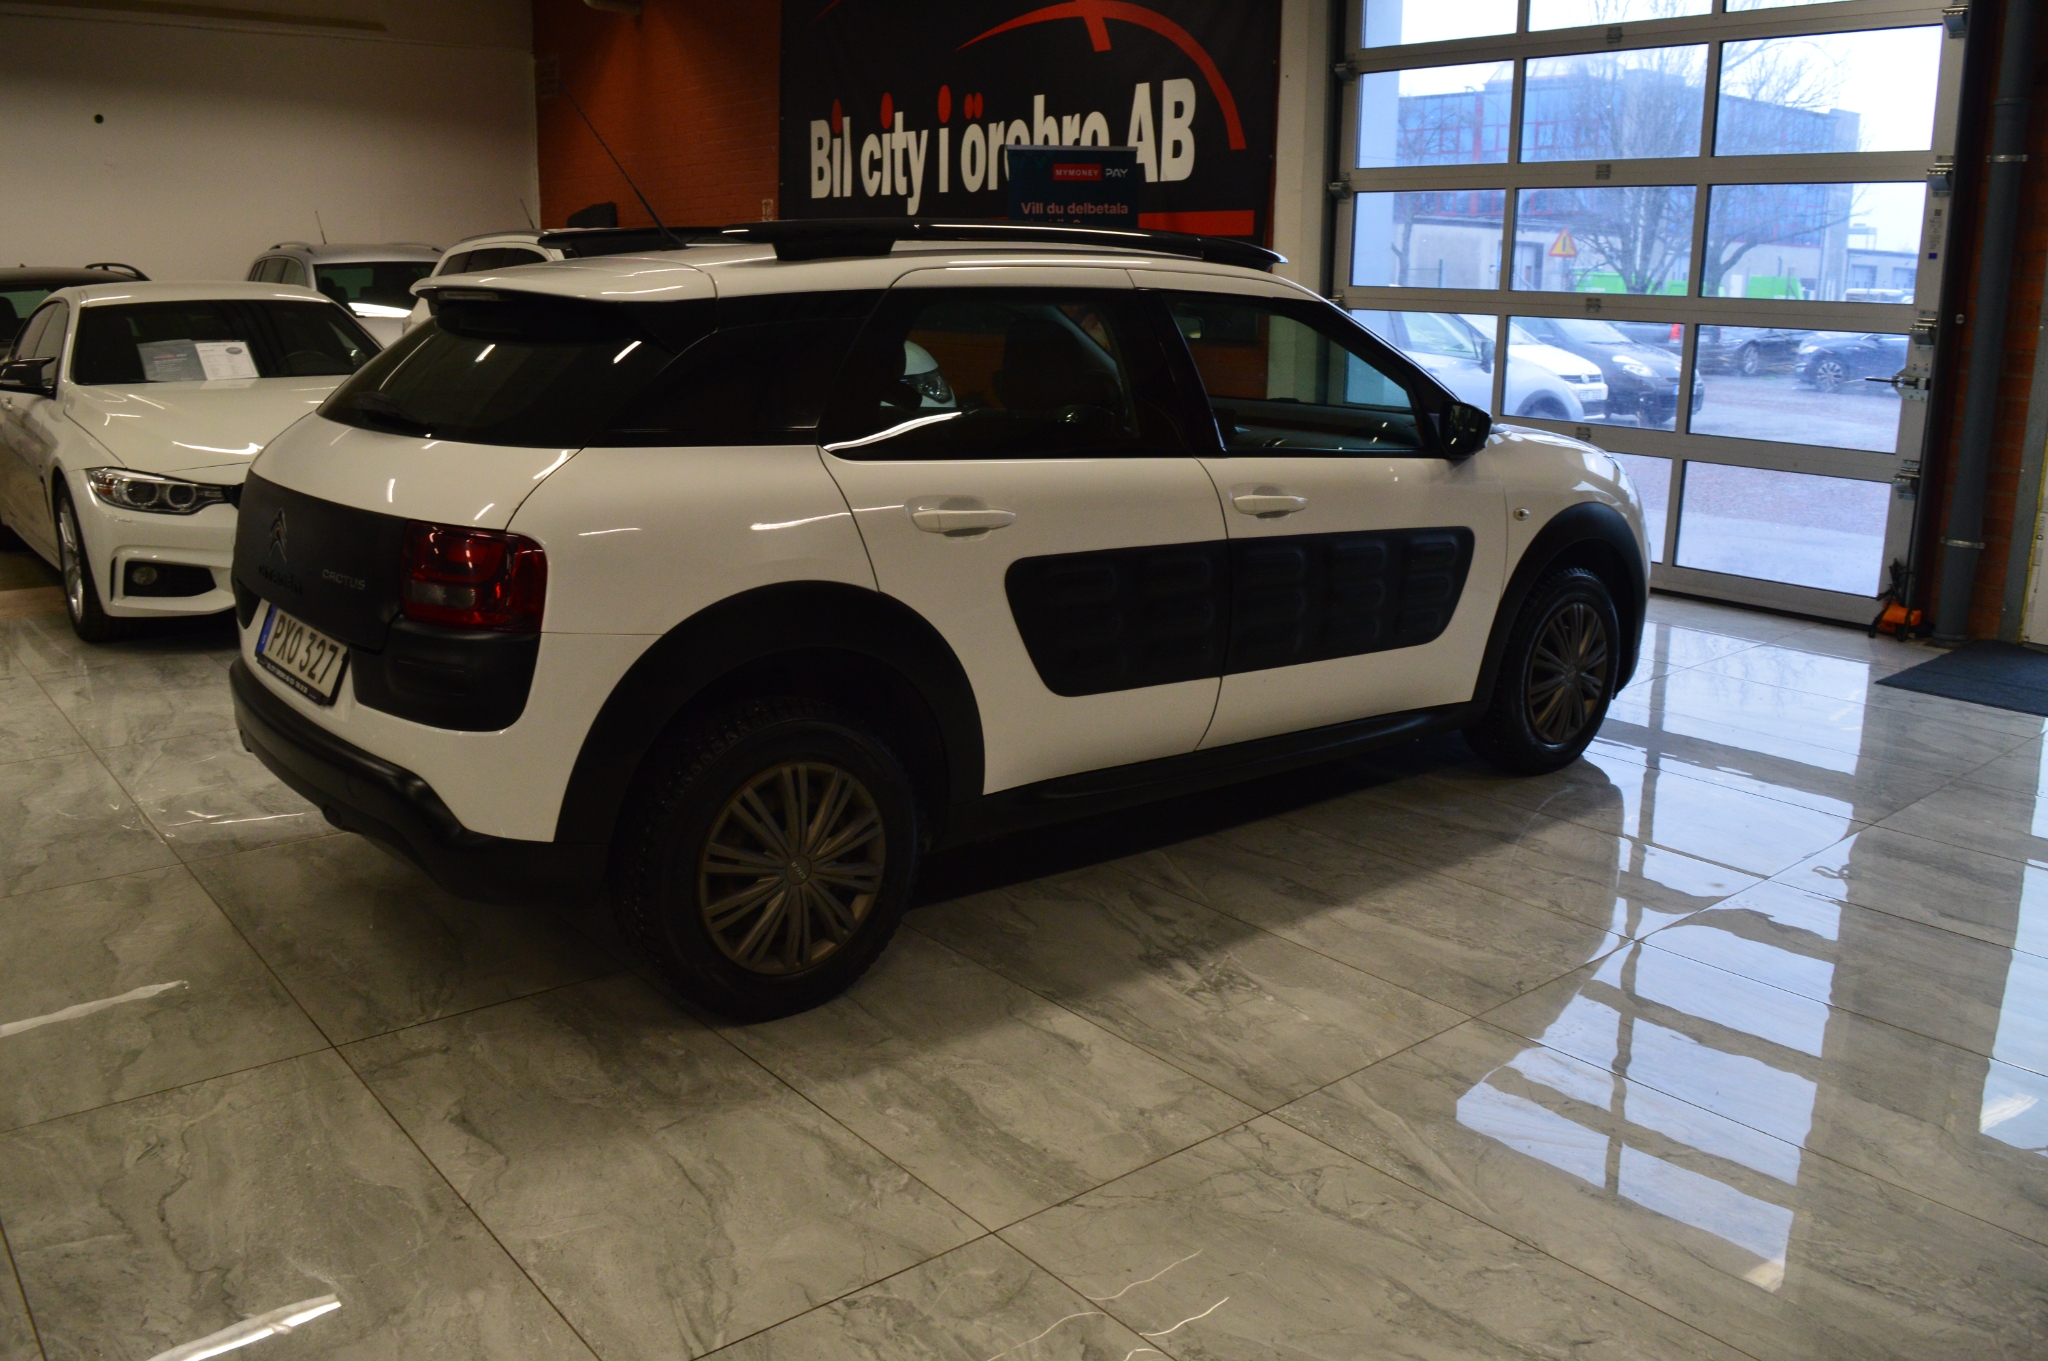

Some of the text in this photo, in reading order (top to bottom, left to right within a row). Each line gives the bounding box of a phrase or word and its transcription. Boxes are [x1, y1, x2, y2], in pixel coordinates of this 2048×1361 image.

[810, 98, 852, 199] Bil
[860, 92, 929, 216] city
[937, 84, 952, 193] i
[1127, 77, 1196, 183] AB
[1055, 168, 1128, 178] MYMONEY PAY
[1021, 202, 1129, 215] Vill du delbetala
[322, 568, 366, 591] CACTUS
[299, 631, 340, 684] 327
